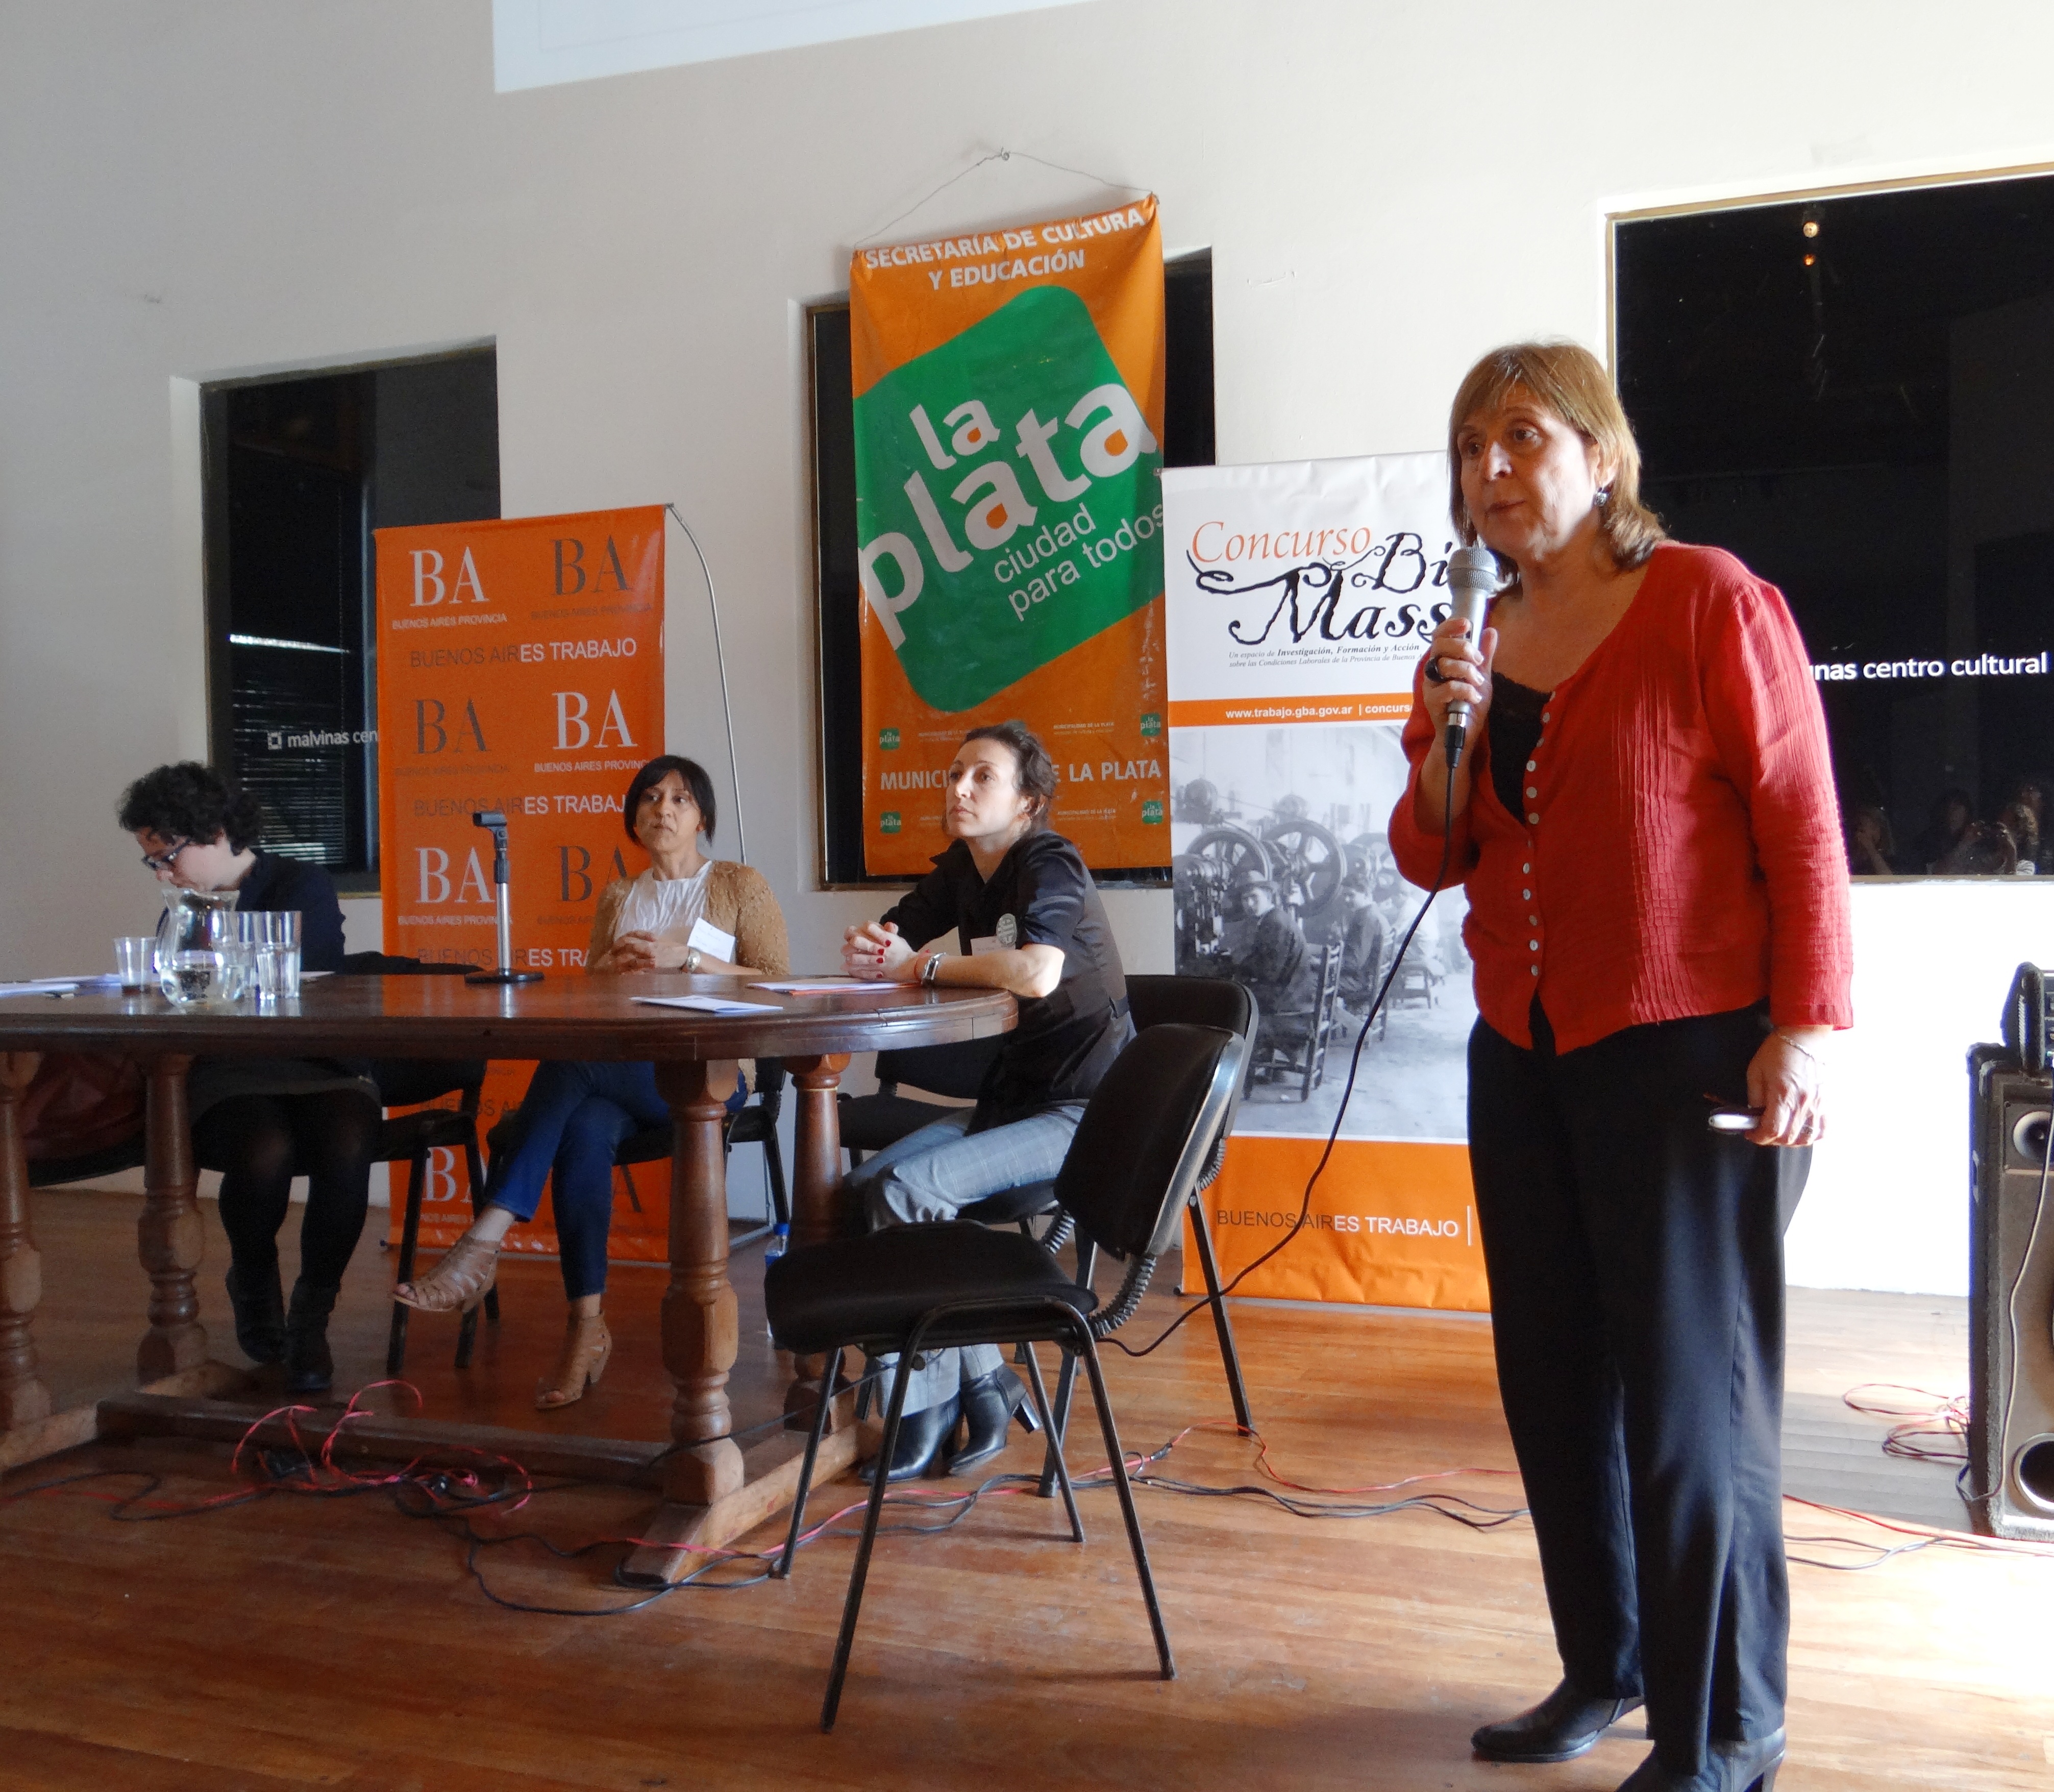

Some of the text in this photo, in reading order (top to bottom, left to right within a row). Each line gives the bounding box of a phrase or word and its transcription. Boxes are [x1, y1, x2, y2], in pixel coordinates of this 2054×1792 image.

[864, 207, 1146, 270] SECRETARÍA DE CULTURA
[928, 248, 1085, 291] Y EDUCACIÓN
[908, 399, 1001, 470] la
[858, 383, 1158, 651] plata
[994, 502, 1097, 583] ciudad
[1007, 504, 1164, 622] para todos
[1192, 521, 1371, 563] Concurso
[1350, 532, 1453, 594] Bi
[409, 546, 490, 607] BA
[549, 534, 633, 596] BA
[1186, 554, 1453, 646] Mass
[410, 637, 637, 668] BUENOS AIRES TRABAJO
[1258, 657, 1297, 666] Condiciones
[1298, 656, 1330, 665] Laborales
[1277, 647, 1333, 657] Investigación,
[1337, 645, 1381, 654] Formación
[1391, 644, 1420, 652] Acción
[1863, 658, 1944, 679] centro
[1950, 652, 2047, 676] cultural
[411, 696, 492, 755] BA
[552, 689, 638, 749] BA
[1140, 721, 1161, 730] plata
[1225, 703, 1413, 719] www.trabajo.gba.gov.ar concurs
[287, 729, 379, 748] malvinas cen
[879, 735, 900, 745] plata
[534, 759, 647, 773] BUENOS AIRES PROVINC
[880, 770, 951, 791] MUNICI
[1069, 763, 1094, 782] LA
[1101, 759, 1162, 781] PLATA
[553, 794, 626, 814] TRABAJ
[880, 819, 902, 827] plata
[1142, 807, 1163, 818] plata
[414, 846, 495, 903] BA
